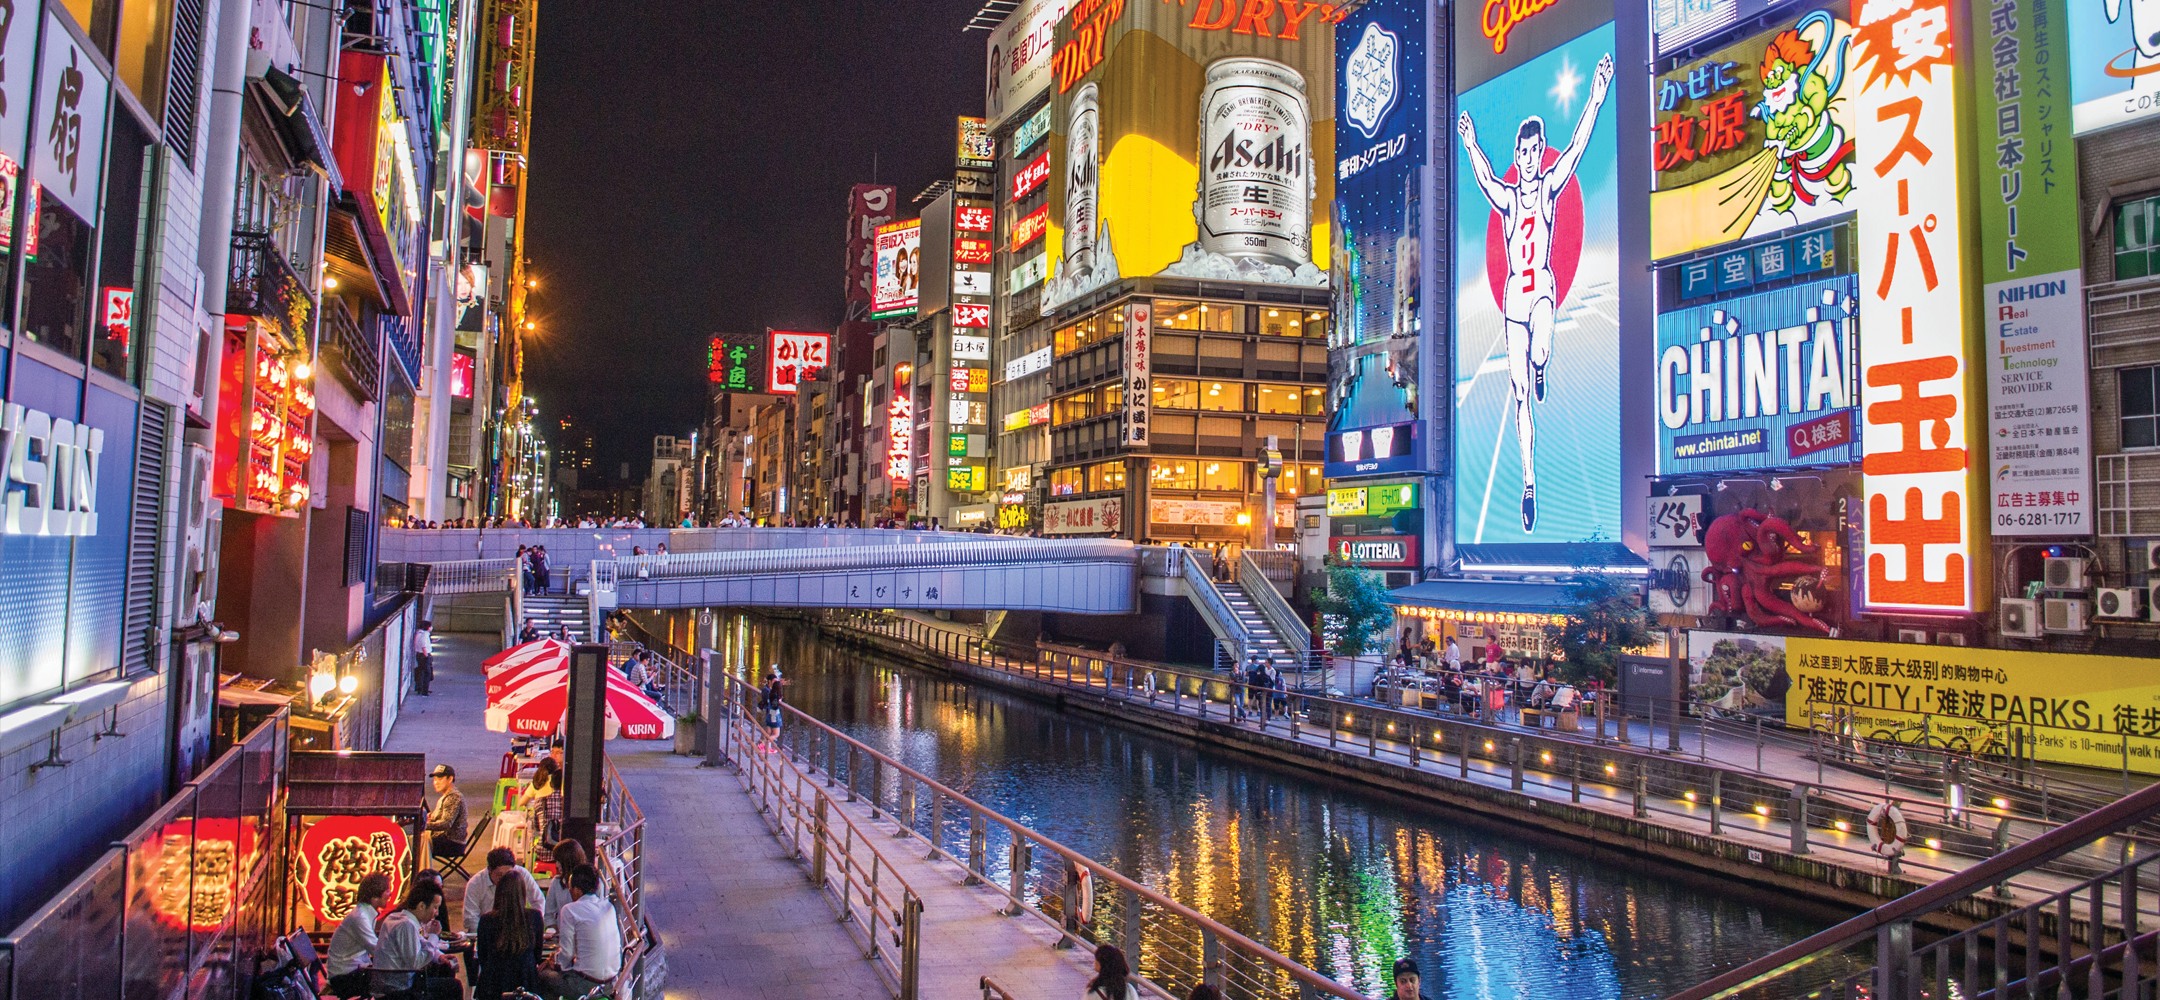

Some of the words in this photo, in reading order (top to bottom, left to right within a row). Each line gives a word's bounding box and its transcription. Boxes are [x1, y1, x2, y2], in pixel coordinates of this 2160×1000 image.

[1658, 61, 1741, 111] かぜに
[1238, 96, 1272, 109] BREWERIES
[1273, 104, 1292, 127] LIMITED
[1651, 90, 1747, 172] 改源
[1992, 0, 2027, 272] 式会社日本リート
[1210, 128, 1301, 178] Asahi
[1338, 133, 1406, 180] 雪印メグミルク
[1067, 151, 1096, 206] Asahi
[1242, 185, 1270, 205] 生
[1230, 207, 1283, 221] スーパードライ
[1244, 236, 1267, 248] 350ml
[1520, 209, 1536, 294] グリコ
[1688, 232, 1826, 292] 戸堂歯科
[1998, 280, 2066, 304] NIHON
[1998, 305, 2029, 321] Real
[2000, 322, 2039, 338] Estate
[776, 338, 823, 362] かに
[954, 340, 985, 353] 白木屋
[2000, 339, 2056, 355] Investment
[1999, 355, 2058, 370] Technology
[2001, 371, 2044, 384] SERVICE
[2002, 382, 2053, 395] PROVIDER
[1811, 419, 1842, 444] 検索
[2012, 425, 2079, 439] 全日本不動産協会
[1674, 430, 1761, 458] www.chintai.net
[1997, 490, 2080, 508] 広告主募集中
[1656, 502, 1691, 539] くくる
[1997, 512, 2081, 527] 06-6281-1717
[1351, 542, 1401, 559] LOTTERIA
[850, 585, 939, 600] えびす橋
[1798, 654, 2008, 684] 从这里到大阪最大级别的购物中心
[516, 718, 549, 731] KIRIN
[627, 723, 656, 735] KIRIN
[2129, 745, 2151, 761] walk
